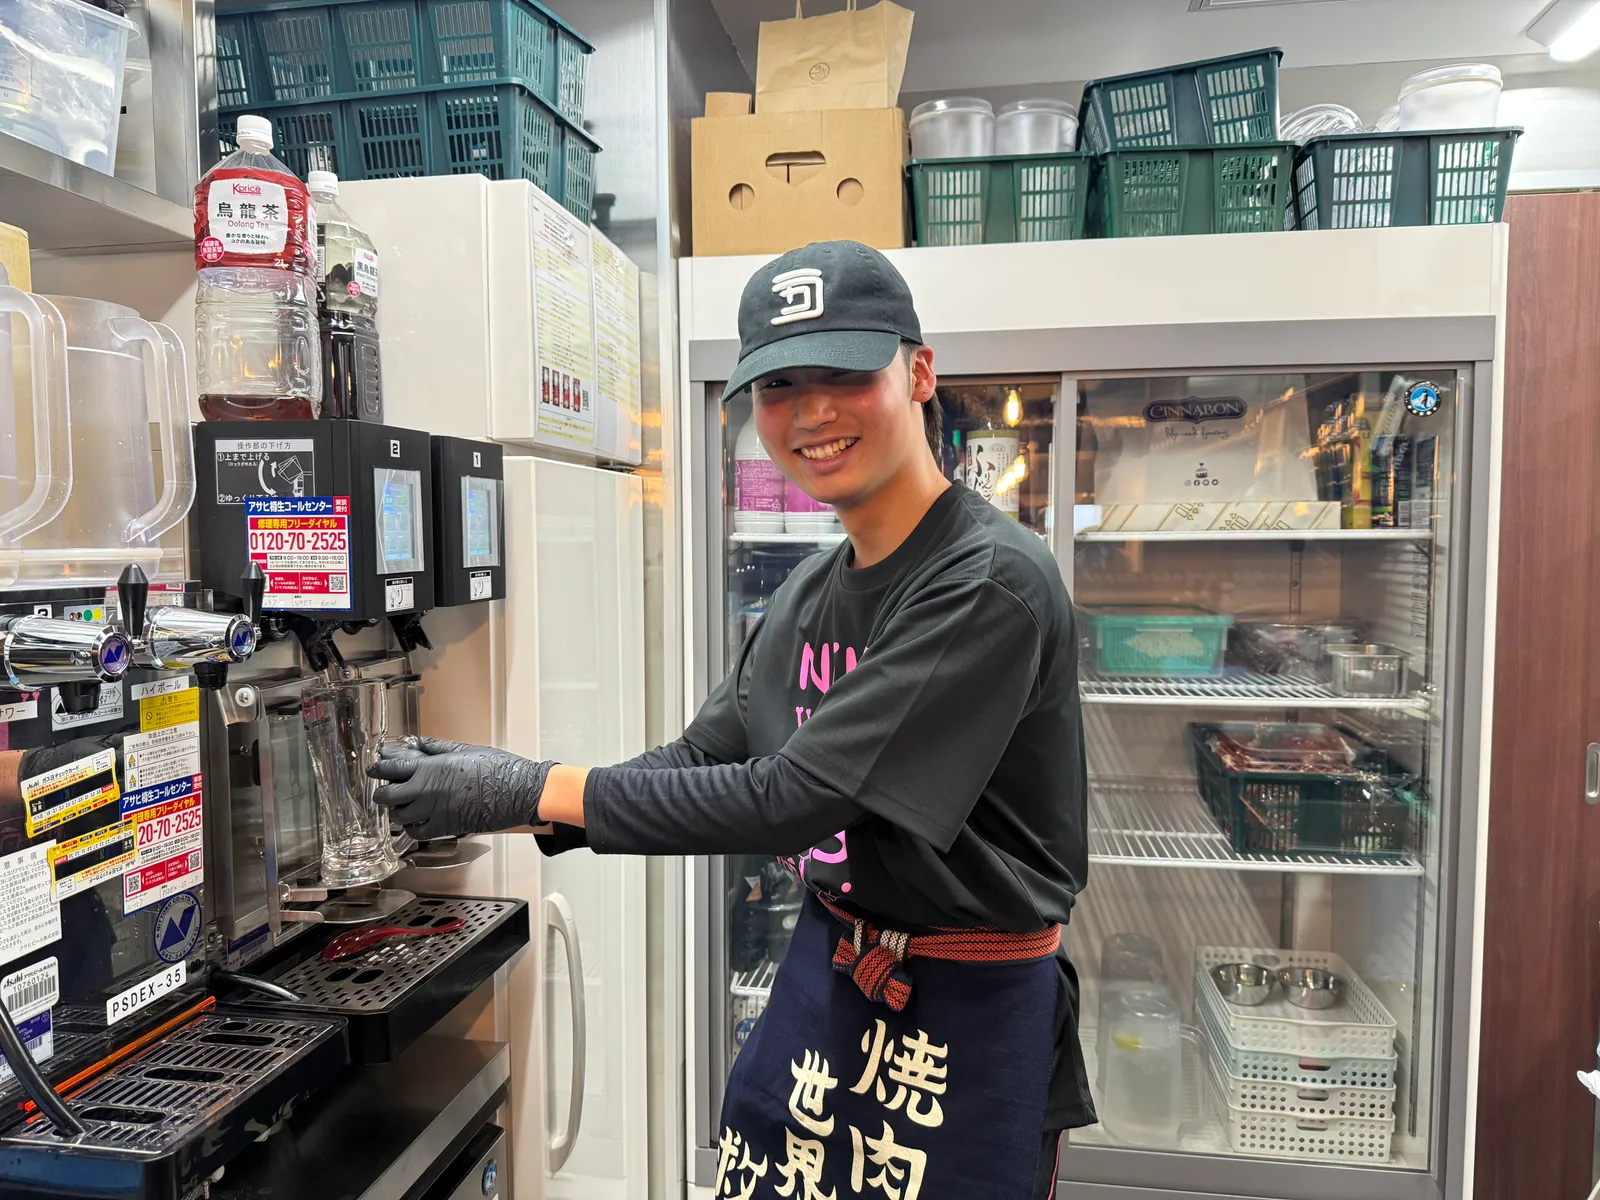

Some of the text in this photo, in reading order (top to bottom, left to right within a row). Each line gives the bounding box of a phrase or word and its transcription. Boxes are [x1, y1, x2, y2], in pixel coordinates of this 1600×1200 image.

[217, 202, 280, 220] 烏龍茶
[228, 220, 269, 229] Oolong Tea
[1149, 402, 1240, 418] CINNABON
[237, 442, 291, 450] 操作部の下げ方
[392, 443, 399, 455] 2
[248, 501, 332, 513] アサヒ樽生コールセンター
[258, 519, 337, 529] 修理専用フリーダイヤル
[250, 532, 346, 550] 0120-70-2525
[141, 680, 181, 696] ハイボール
[123, 783, 191, 809] アサヒ樽生コールセンター
[131, 797, 195, 823] 理専用フリーダイヤル
[138, 808, 201, 846] 20-70-2525
[4, 972, 23, 989] Asahi
[113, 968, 181, 1018] PSDEX-35
[849, 1018, 948, 1200] 焼肉
[774, 1048, 838, 1200] 世界
